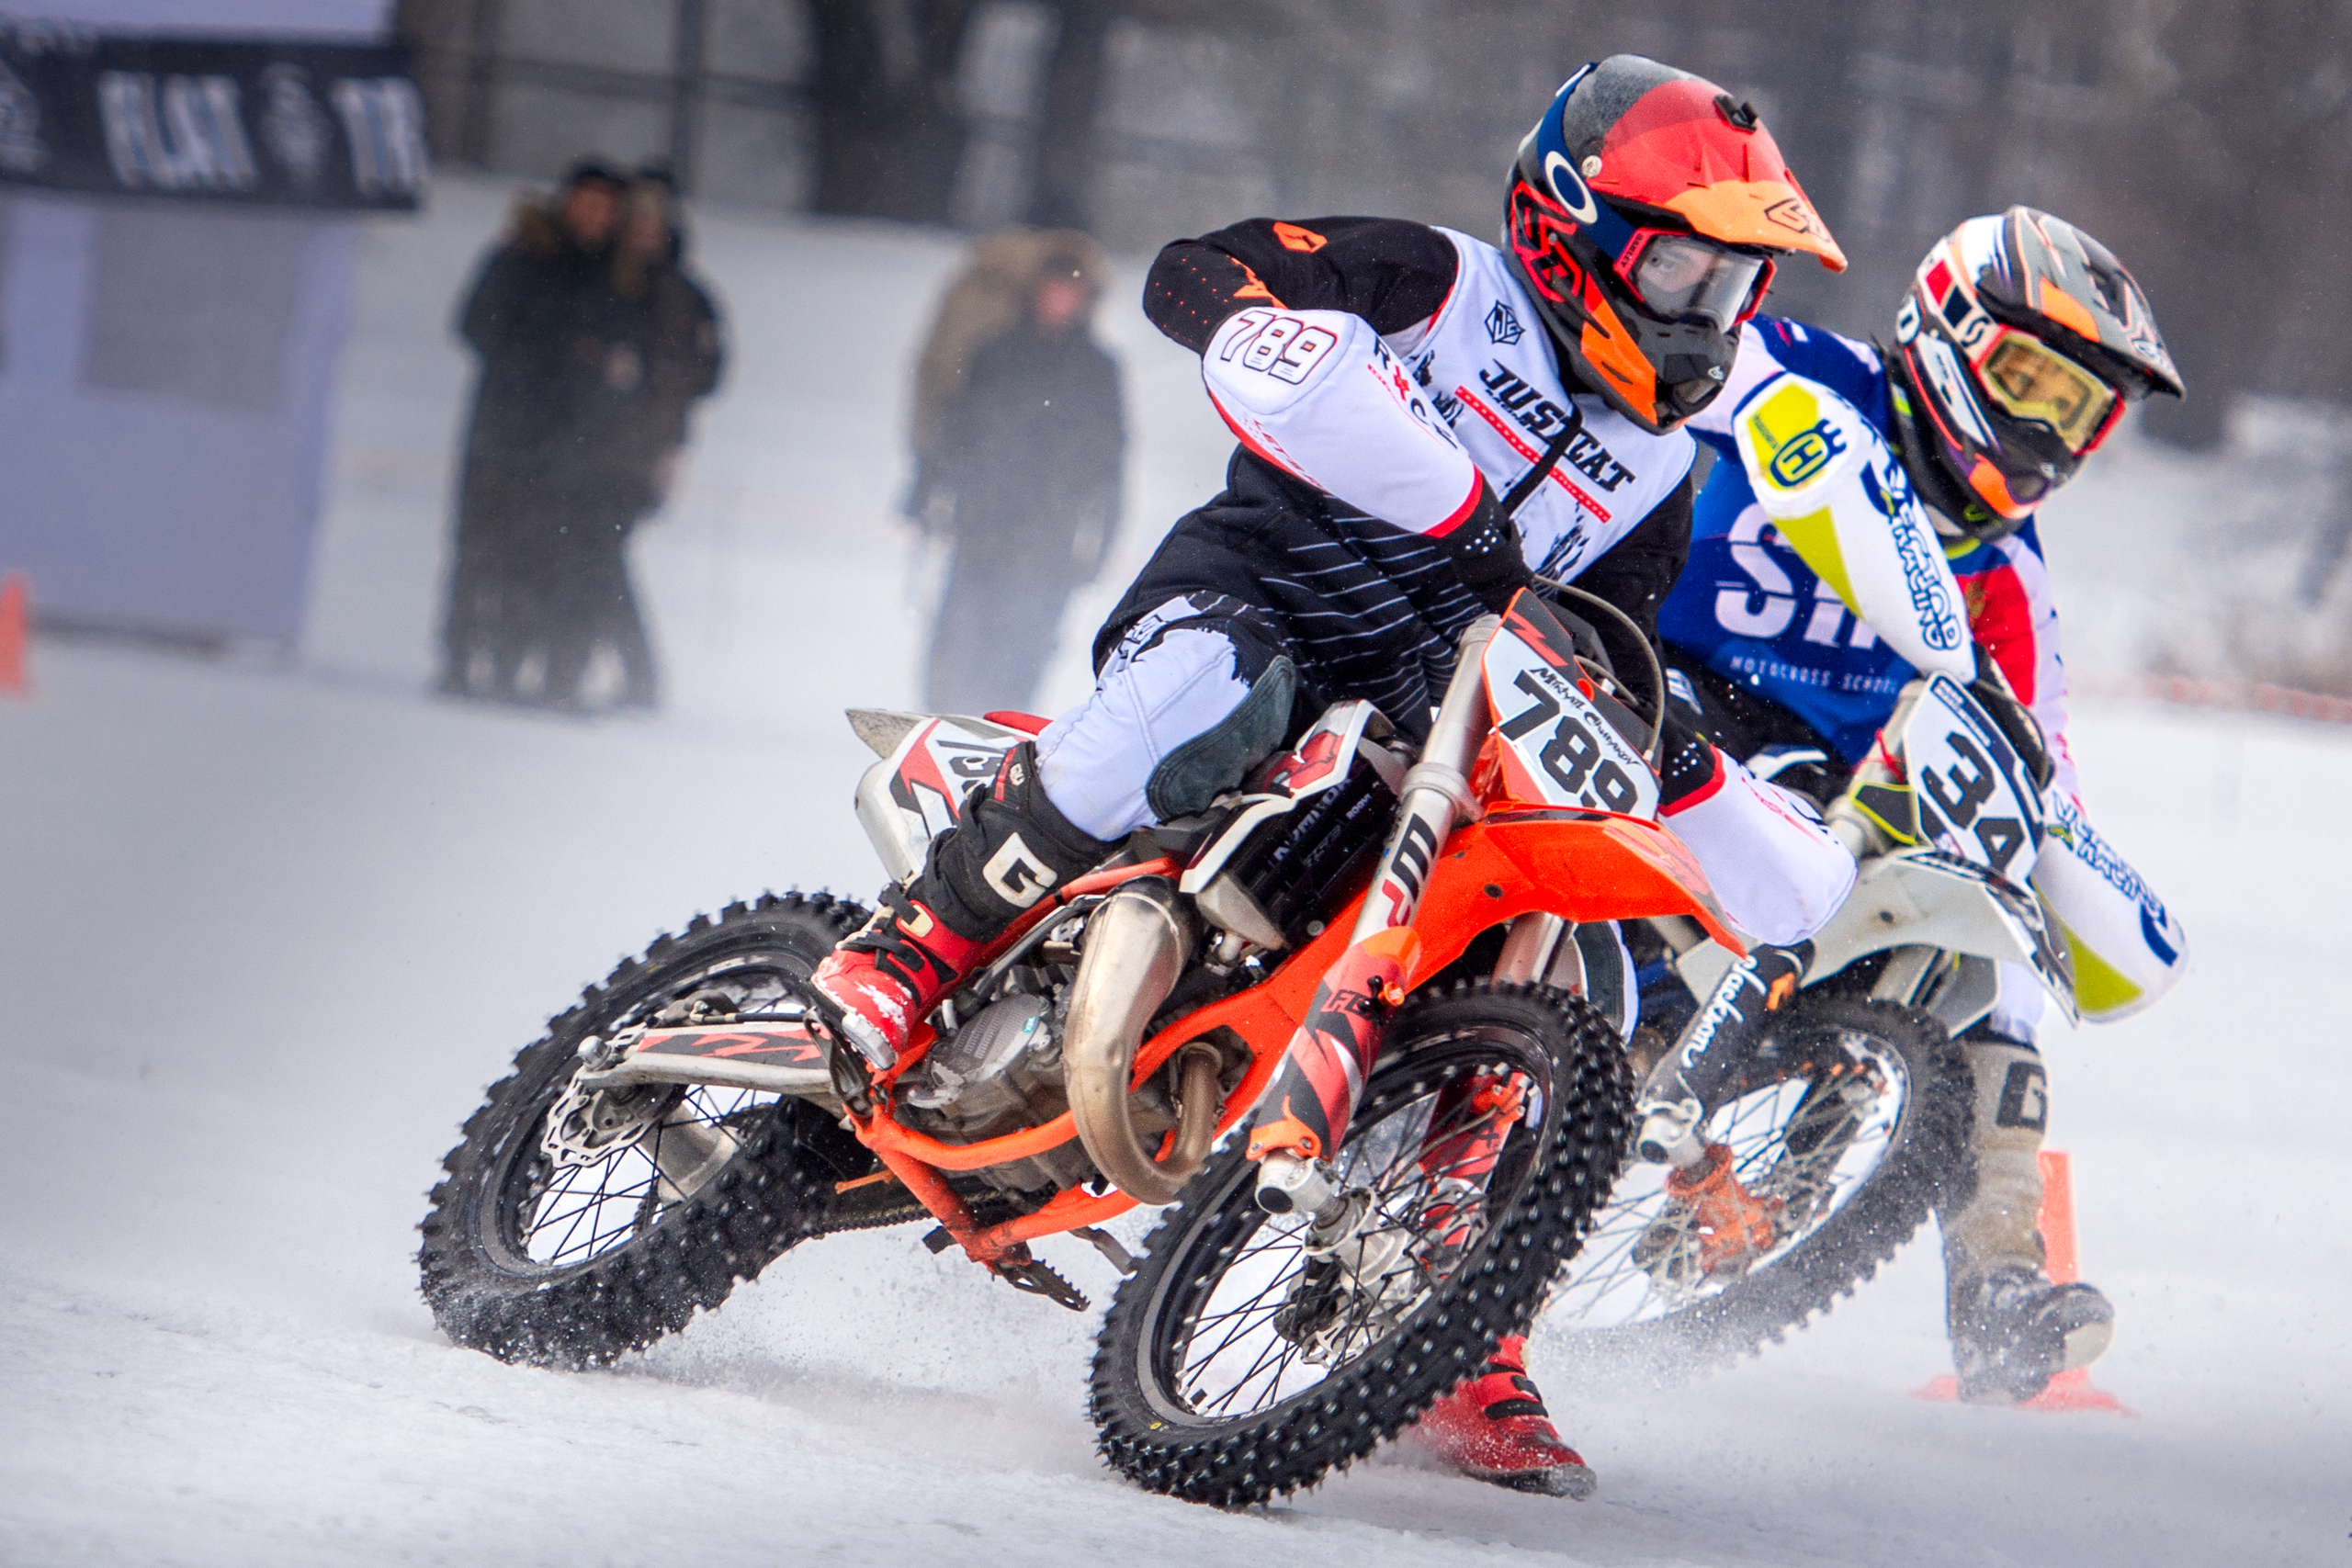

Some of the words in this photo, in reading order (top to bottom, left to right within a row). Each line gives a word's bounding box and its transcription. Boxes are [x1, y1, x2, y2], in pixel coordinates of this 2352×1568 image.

[1220, 310, 1339, 386] 789
[1728, 655, 1832, 687] MOTOCROSS
[1498, 669, 1640, 816] 789
[1920, 731, 2026, 874] 34
